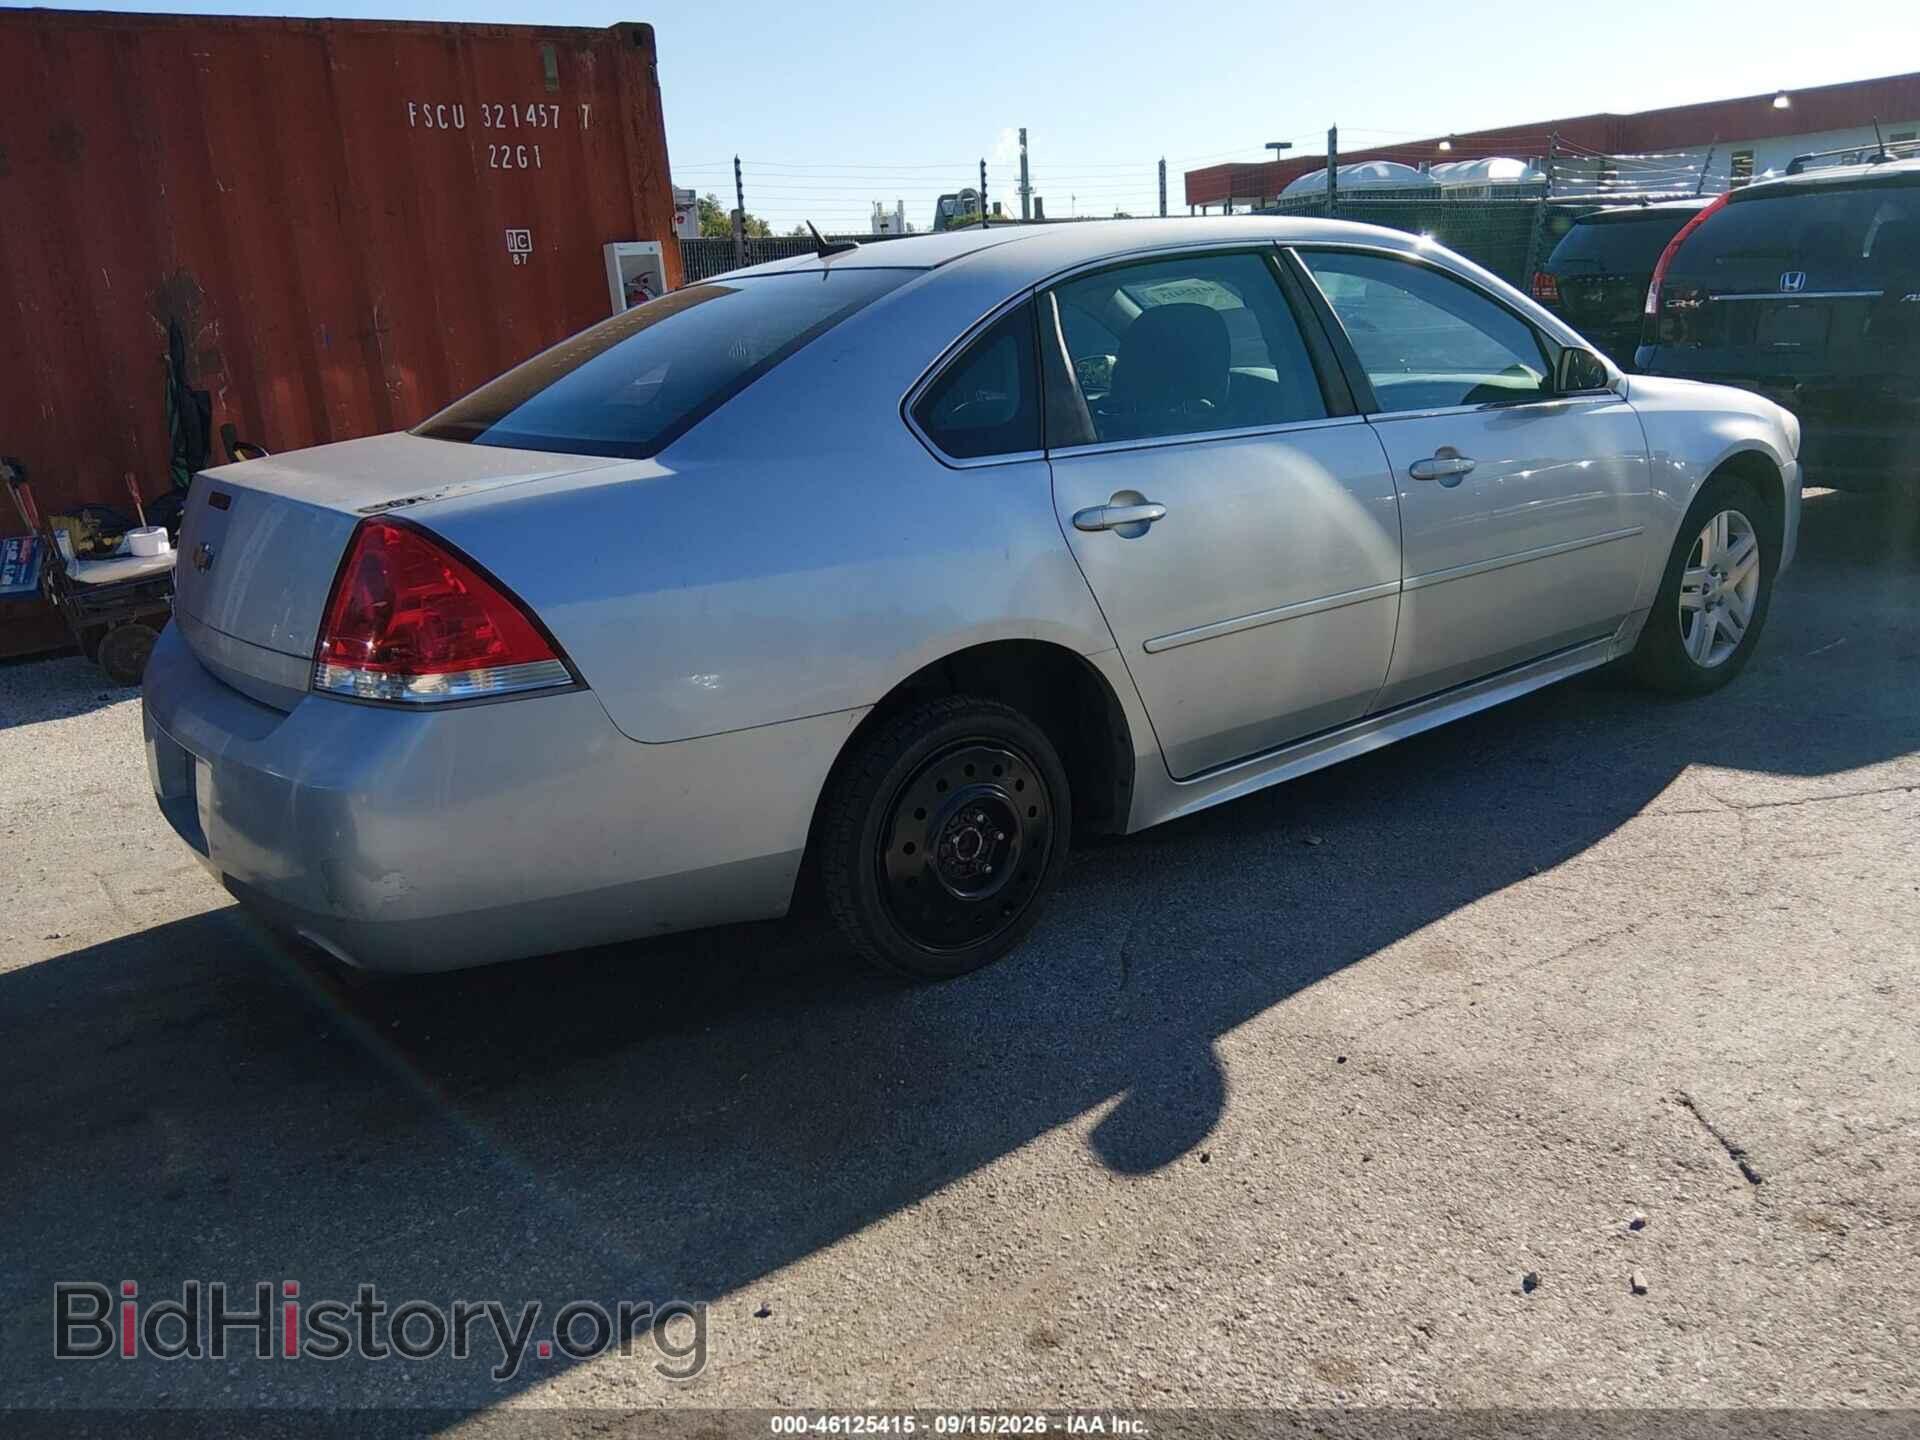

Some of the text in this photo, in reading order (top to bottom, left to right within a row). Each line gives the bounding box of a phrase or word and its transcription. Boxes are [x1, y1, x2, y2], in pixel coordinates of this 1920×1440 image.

[409, 102, 592, 129] FSCU 321457 7
[489, 145, 542, 168] 22G1
